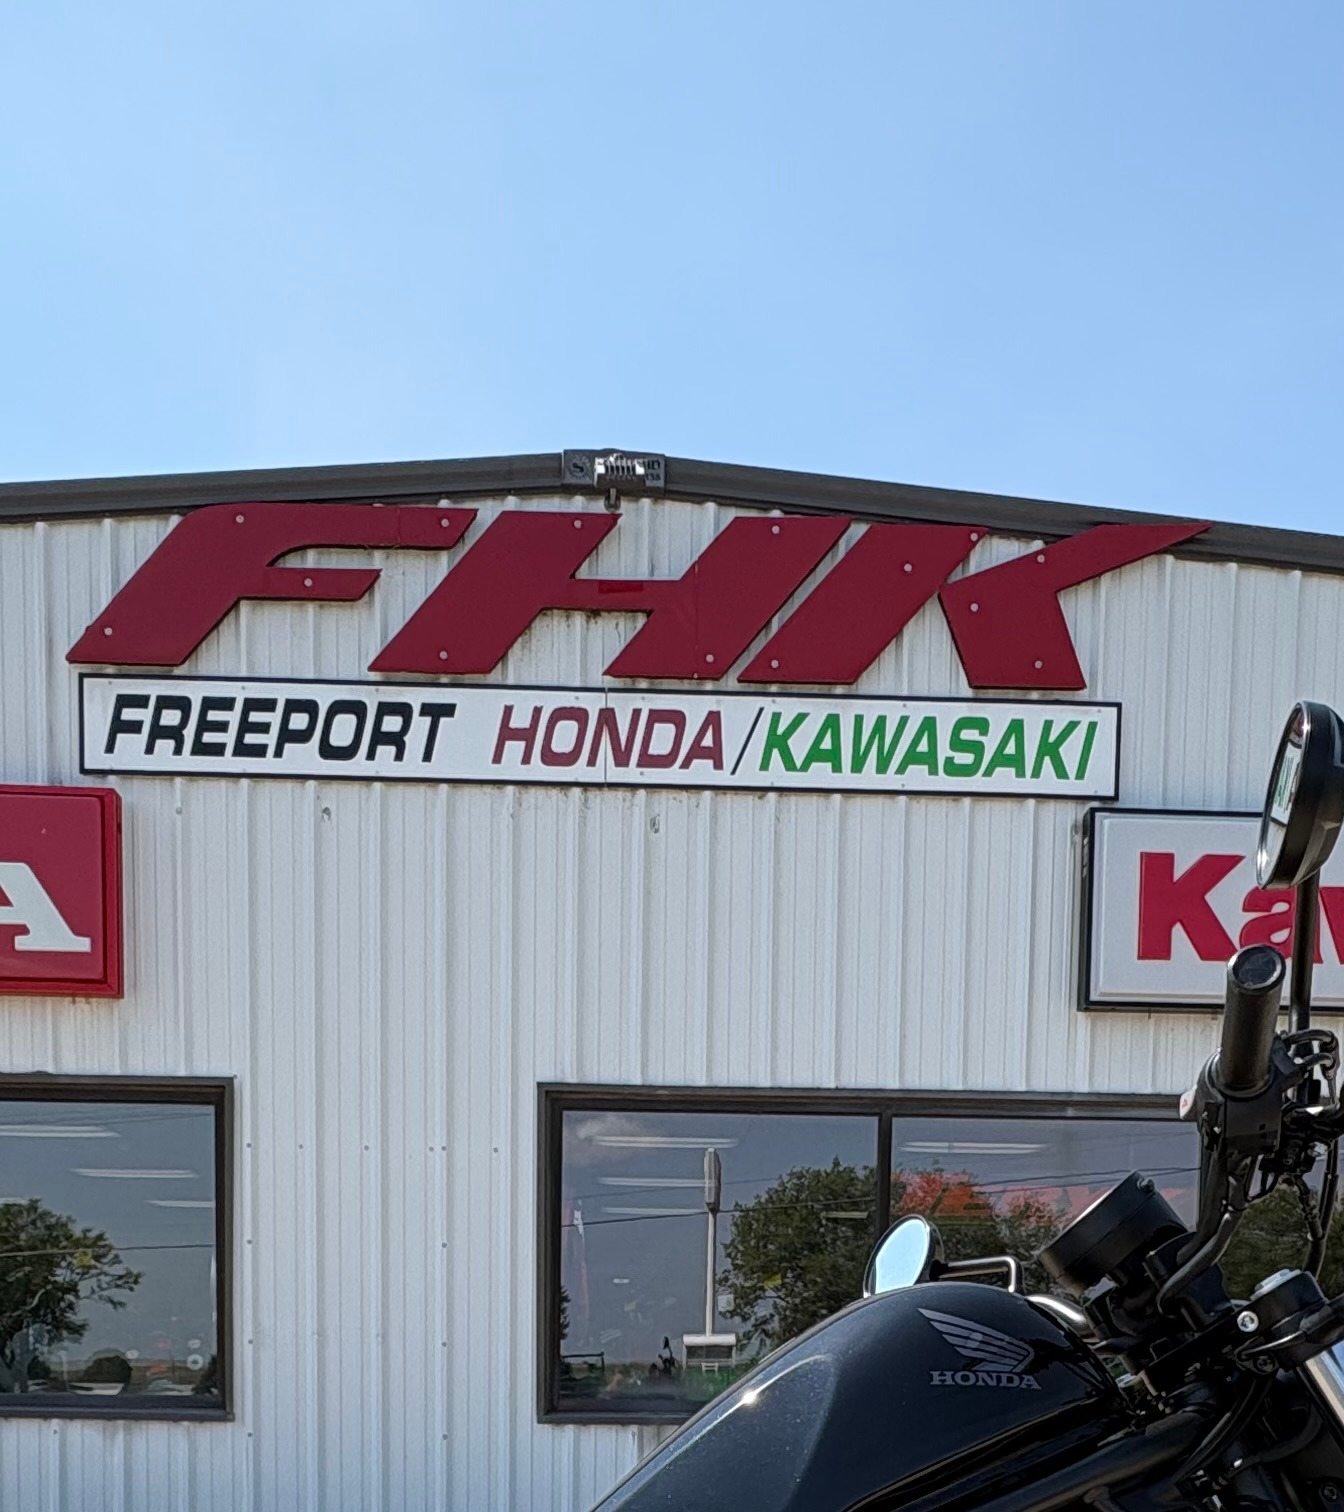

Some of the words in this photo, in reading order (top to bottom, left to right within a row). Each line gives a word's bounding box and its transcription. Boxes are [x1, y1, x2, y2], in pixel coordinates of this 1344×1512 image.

[65, 502, 1213, 690] FHK
[105, 692, 456, 764] FREEPORT
[492, 703, 1099, 782] HONDA/KAWASAKI
[930, 1370, 1042, 1391] HONDA
